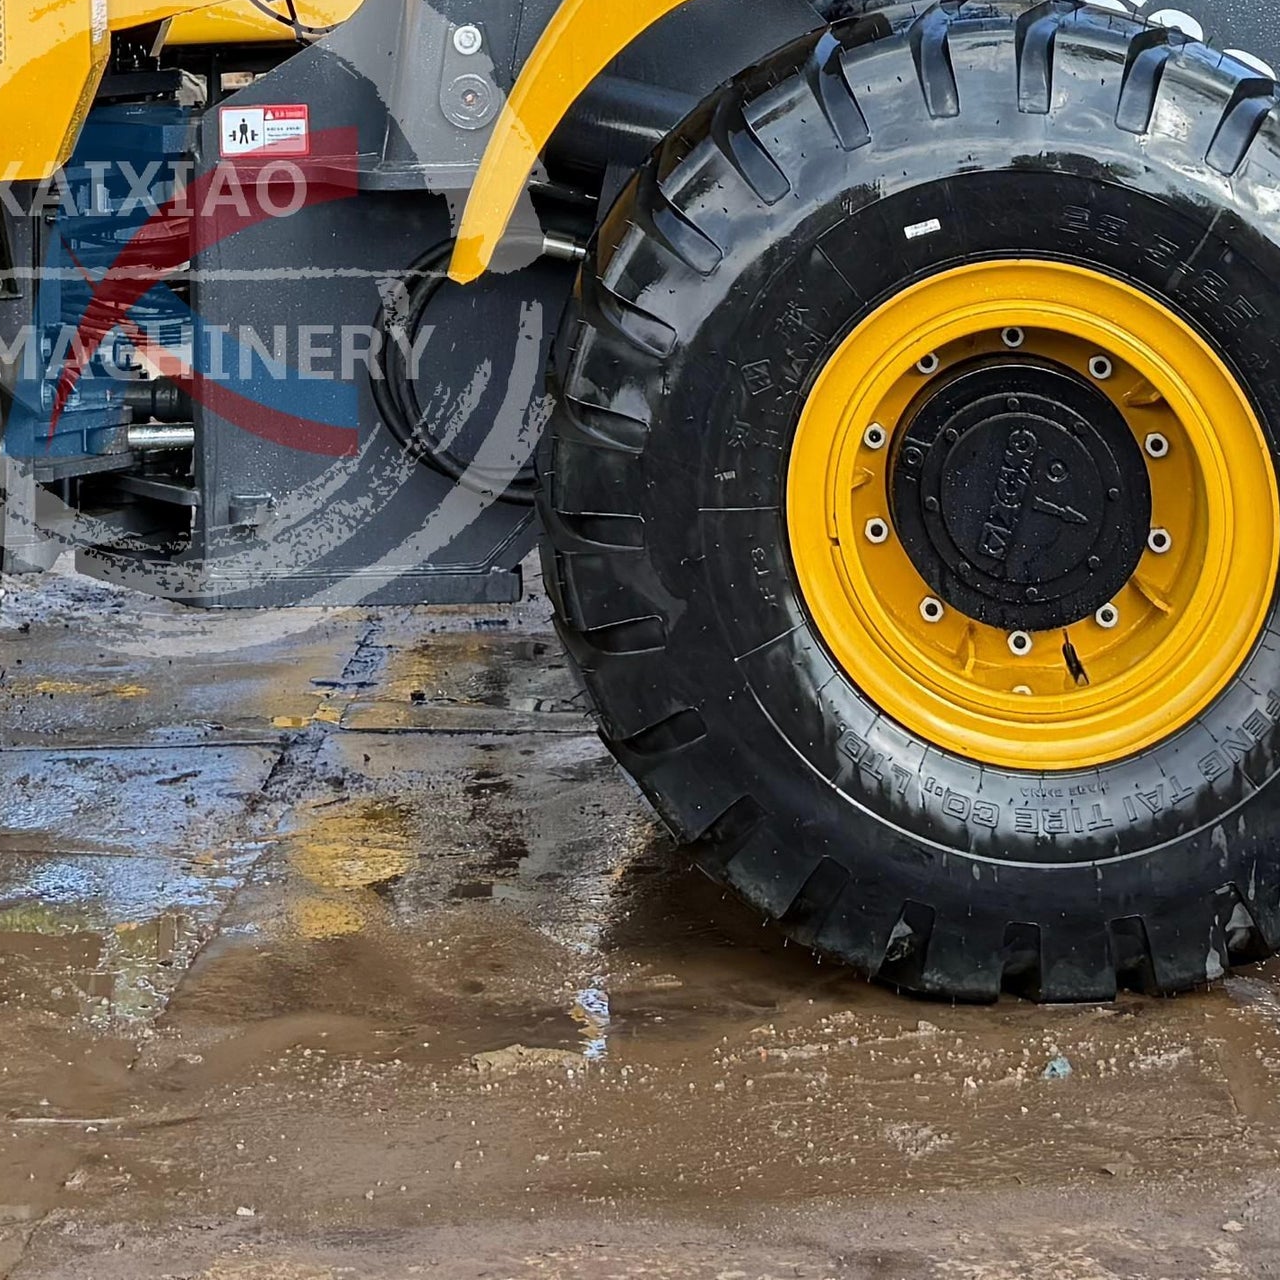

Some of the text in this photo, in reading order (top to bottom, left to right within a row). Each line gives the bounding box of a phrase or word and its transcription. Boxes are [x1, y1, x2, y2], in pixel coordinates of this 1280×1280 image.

[836, 722, 914, 796] LTD.
[1014, 803, 1114, 834] TIRE
[1123, 775, 1195, 823] TAI
